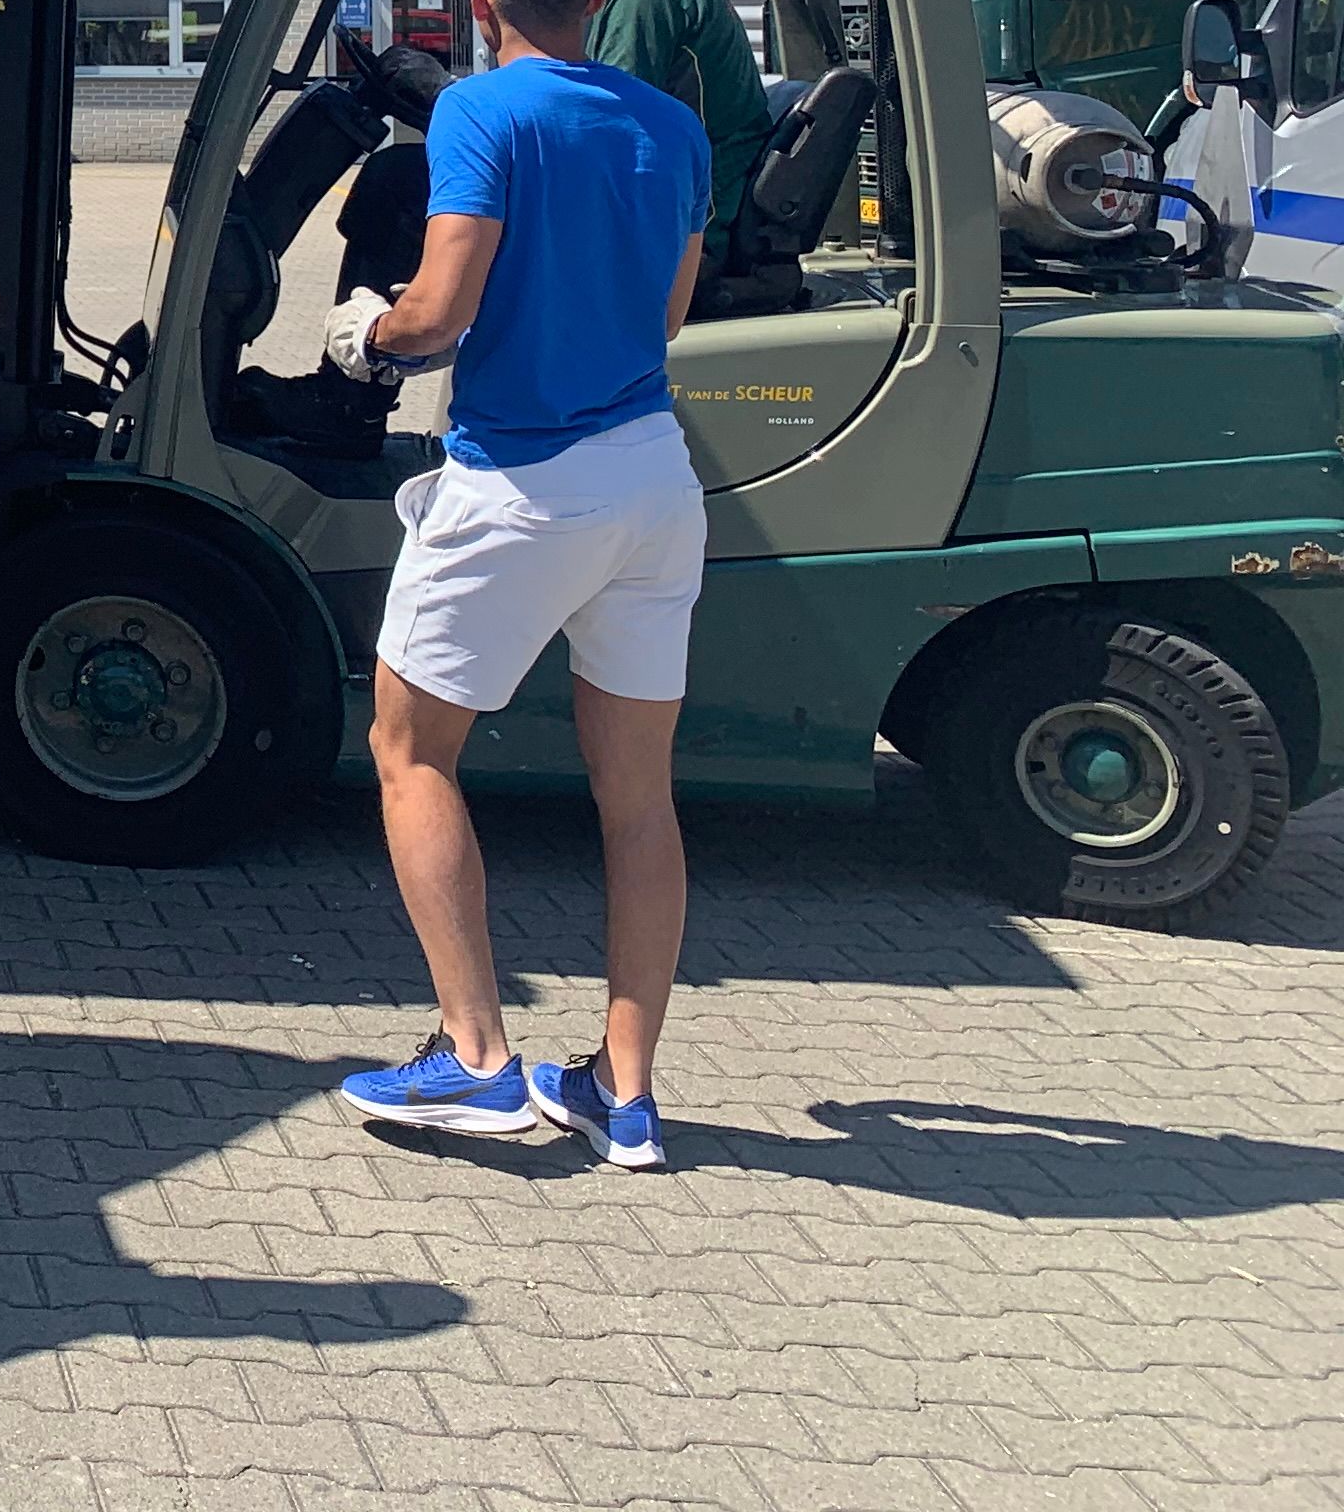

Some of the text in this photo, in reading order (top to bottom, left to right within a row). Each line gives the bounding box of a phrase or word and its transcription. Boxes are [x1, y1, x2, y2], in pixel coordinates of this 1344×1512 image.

[686, 391, 711, 400] VAN
[715, 391, 730, 400] DE
[735, 386, 814, 402] SCHEUR
